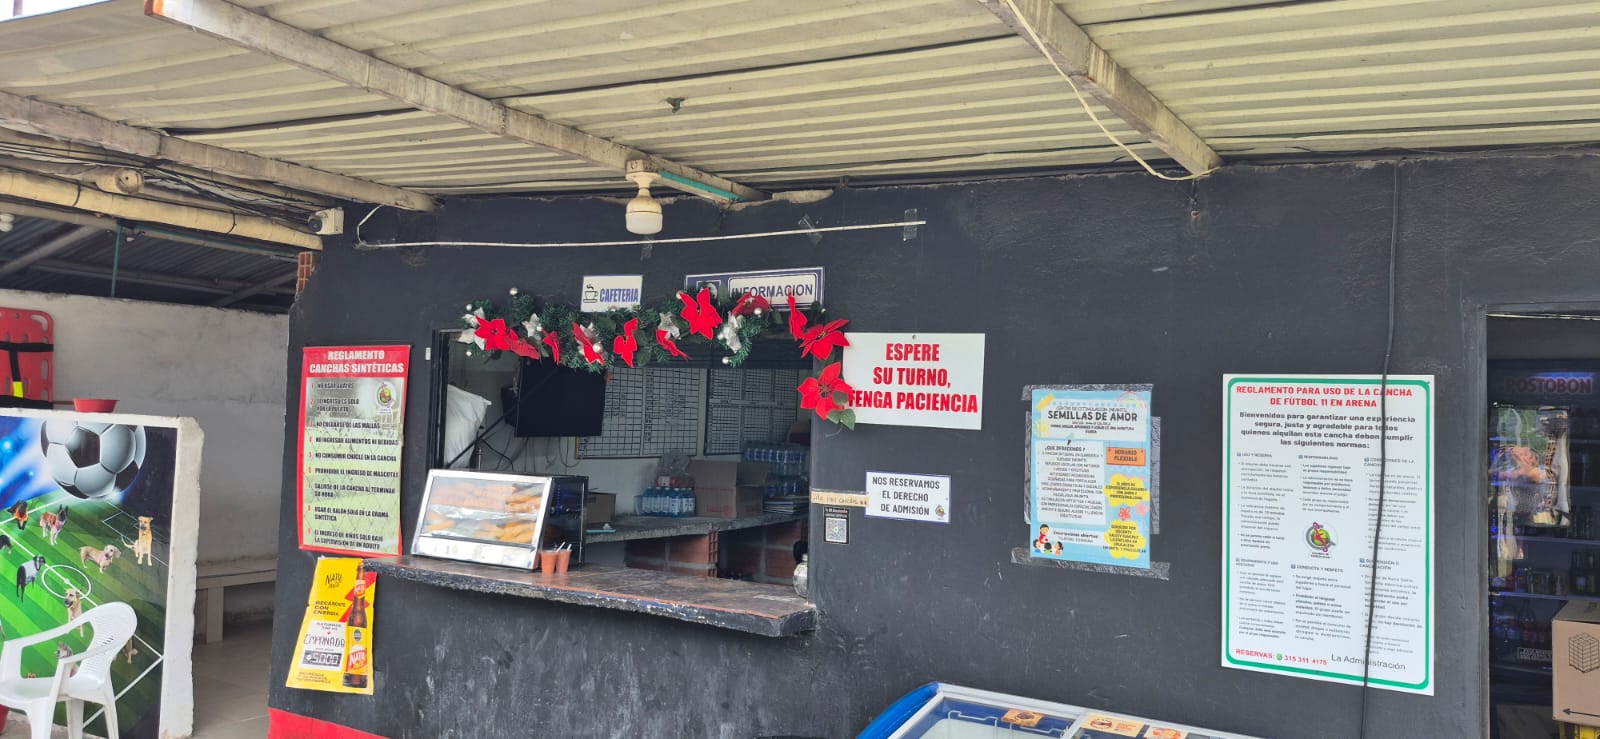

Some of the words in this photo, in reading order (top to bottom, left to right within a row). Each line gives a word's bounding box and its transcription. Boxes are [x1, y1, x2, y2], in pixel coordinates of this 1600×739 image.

[599, 287, 639, 303] CAFETERIA
[731, 283, 813, 298] INFORMACION
[328, 350, 385, 361] REGLAMENTO
[886, 343, 940, 362] ESPERE
[309, 363, 350, 374] CANCHAS
[351, 362, 404, 373] SINTÉTICAS
[873, 367, 893, 385] SU
[897, 367, 951, 389] TURNO,
[1236, 386, 1294, 395] REGLAMENTO
[1296, 387, 1321, 395] PARA
[1344, 388, 1355, 396] DE
[1358, 388, 1371, 396] LA
[1373, 388, 1413, 397] CNCHA
[896, 392, 978, 413] PACIENCIA
[1284, 396, 1318, 406] FÚTBOL
[1321, 399, 1328, 407] 11
[1345, 399, 1377, 407] ARENA
[1048, 410, 1093, 420] SEMILLAS
[1095, 412, 1107, 420] DE
[1110, 412, 1138, 421] AMOR
[1239, 411, 1285, 419] Bienvenidos
[1287, 413, 1305, 421] para
[1307, 414, 1347, 422] garantizar
[1366, 416, 1416, 424] expriencia
[1254, 421, 1283, 429] segura,
[1284, 421, 1304, 430] justa
[1312, 423, 1352, 431] agradable
[1354, 424, 1373, 432] para
[1241, 429, 1271, 438] quienes
[1272, 430, 1302, 439] alquilan
[1324, 431, 1353, 439] cancha
[1354, 432, 1379, 440] deben
[1280, 438, 1292, 446] las
[1294, 439, 1335, 448] siguientes
[1336, 441, 1370, 449] normas:
[872, 476, 887, 485] NOS
[889, 477, 940, 489] RESERVAMOS
[882, 490, 891, 499] EL
[893, 491, 929, 502] DERECHO
[881, 504, 891, 512] DE
[1235, 648, 1276, 659] RESERVAS:
[1331, 653, 1342, 663] La
[1343, 655, 1406, 671] Admiistración
